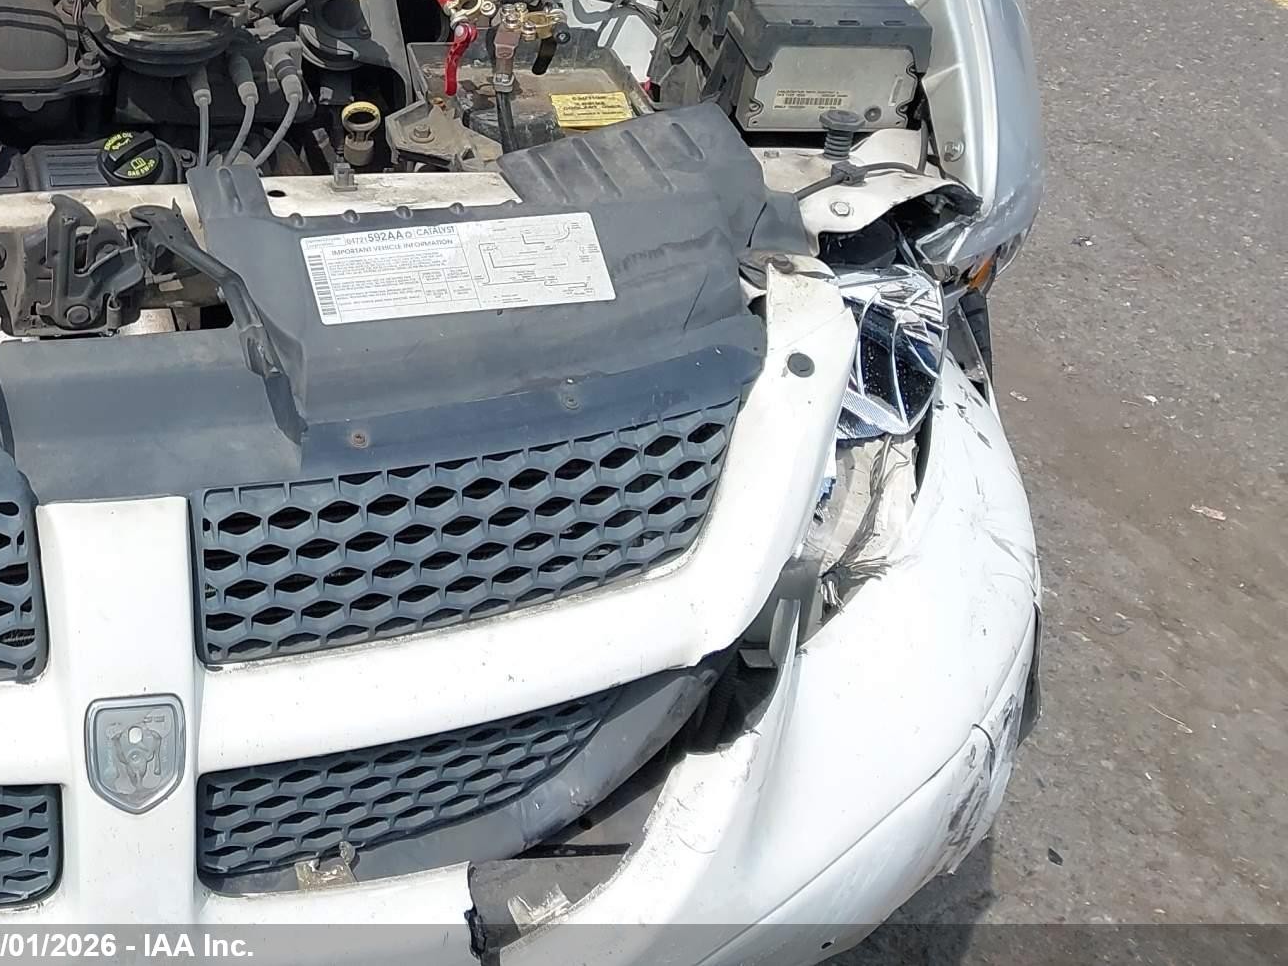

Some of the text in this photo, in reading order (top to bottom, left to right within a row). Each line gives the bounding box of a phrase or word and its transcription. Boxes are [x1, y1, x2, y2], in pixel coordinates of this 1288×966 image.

[416, 226, 455, 235] CATALYST
[331, 239, 453, 256] IMPORTANT VEHICLE INFORMATION
